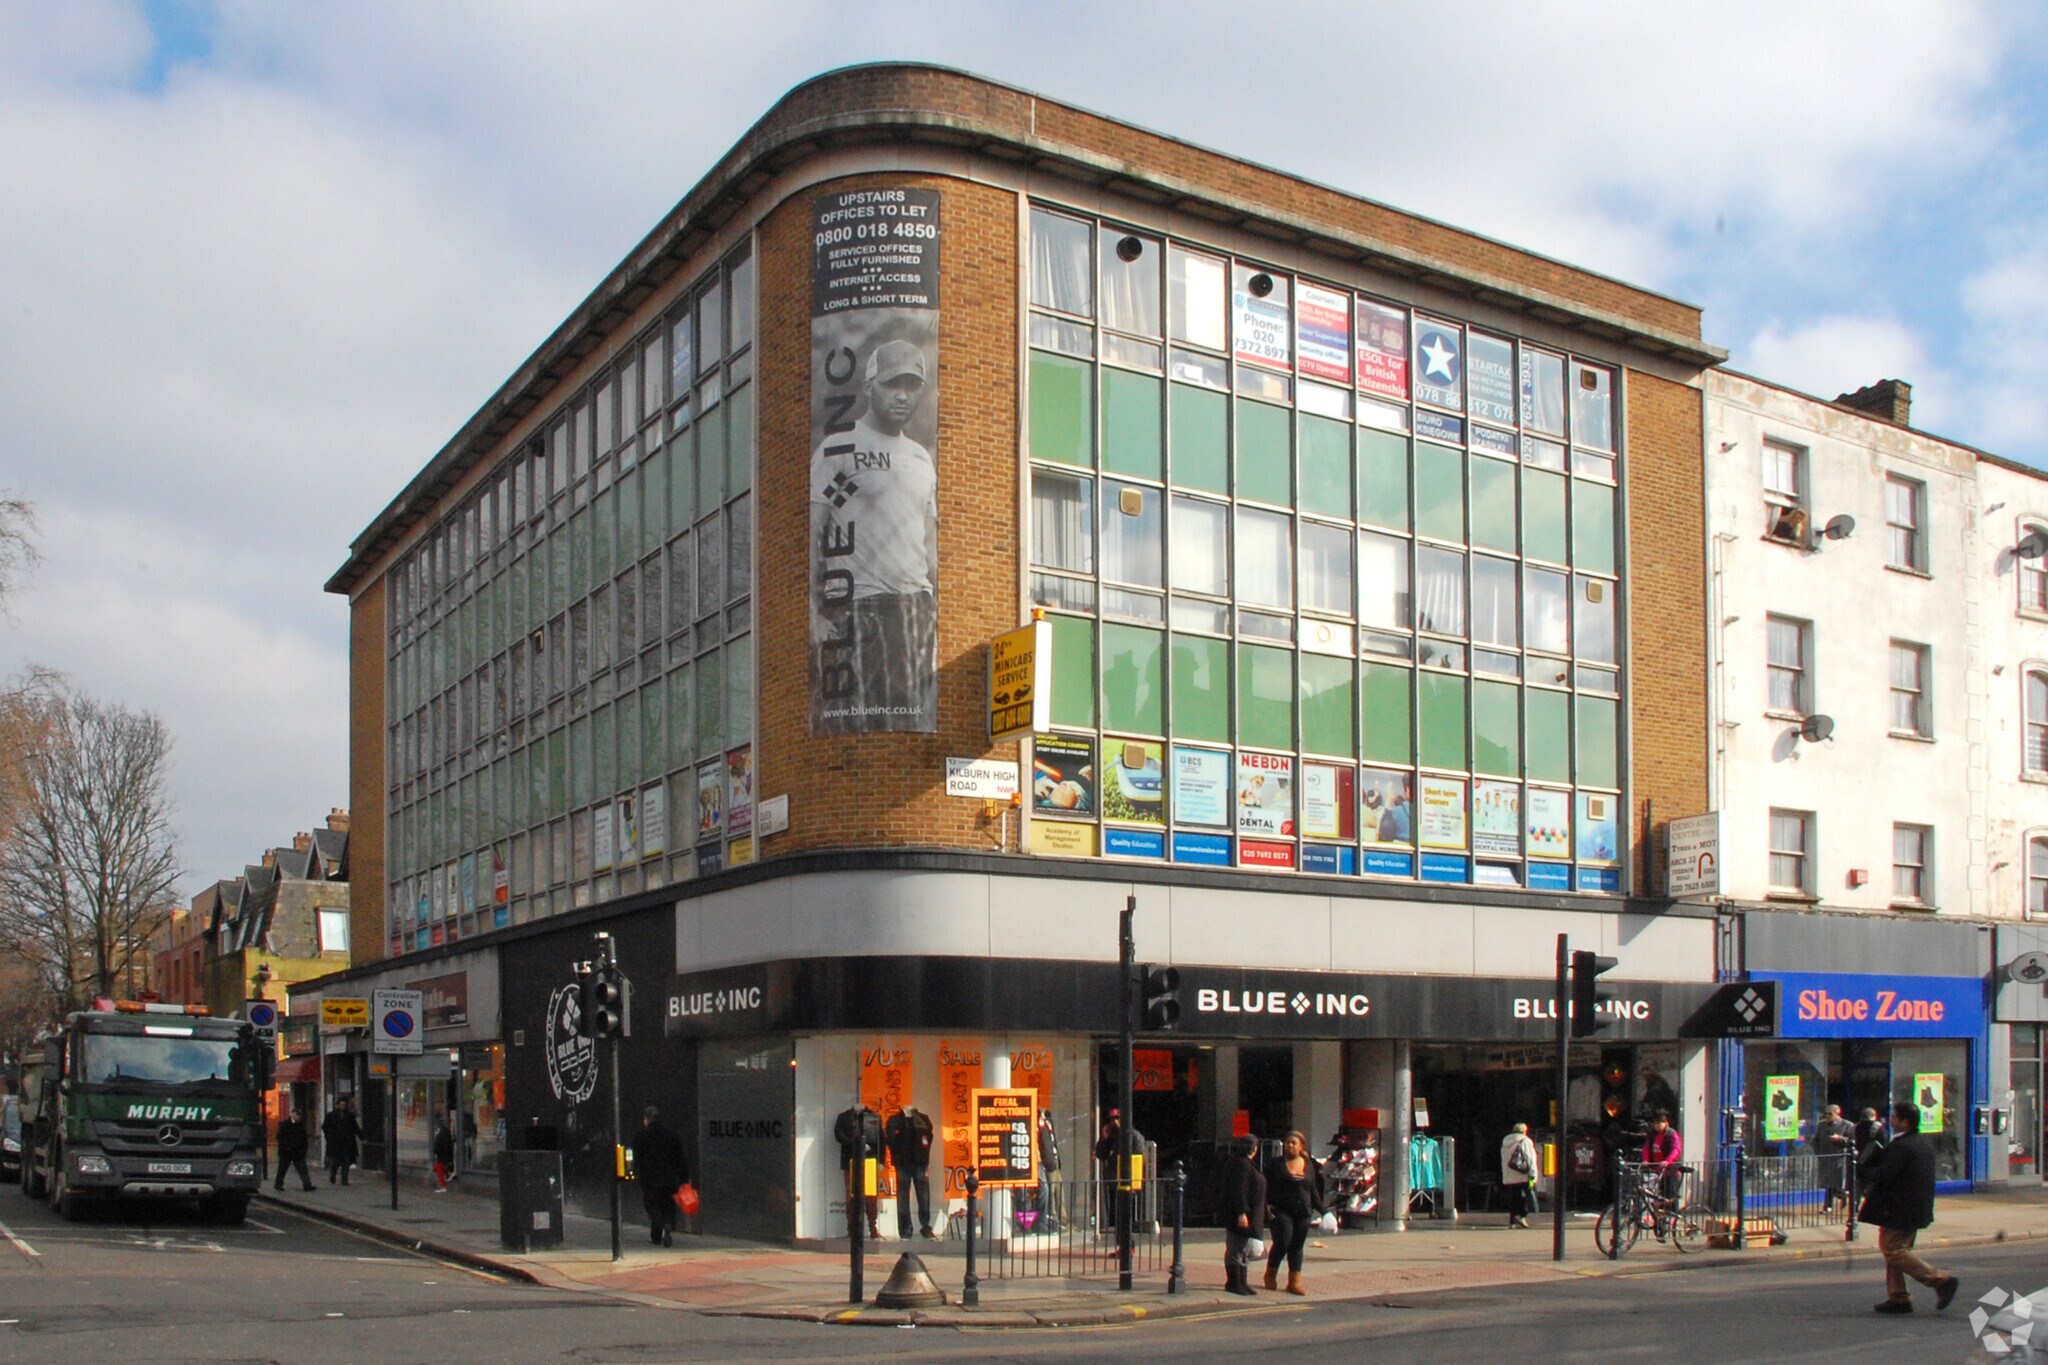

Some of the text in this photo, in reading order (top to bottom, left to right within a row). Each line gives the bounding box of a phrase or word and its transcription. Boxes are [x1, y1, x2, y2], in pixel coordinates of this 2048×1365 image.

[839, 191, 905, 206] UPSTAIRS
[821, 205, 927, 225] OFFICES TO LET
[816, 223, 936, 247] 0800 018 4850
[829, 244, 922, 259] SERVICED OFFICES
[831, 255, 920, 270] FULLY FURNISHED
[829, 274, 921, 288] INTERNET ACCESS
[823, 299, 849, 311] LONG
[861, 295, 896, 305] SHORT
[899, 295, 928, 305] TERM
[1253, 329, 1275, 344] 020
[1234, 338, 1262, 354] 7372
[1359, 350, 1402, 370] ESOL for
[1365, 364, 1397, 382] British
[1358, 375, 1406, 398] Citizenship
[1416, 386, 1461, 408] 078 86
[1522, 437, 1533, 462] 020
[854, 451, 891, 470] RAW
[822, 345, 857, 700] BLUE INC
[994, 651, 1033, 674] MINICABS
[997, 667, 1028, 687] SERVICE
[823, 704, 923, 719] www.blueinc.co.uk
[1241, 754, 1289, 770] NEBDN
[949, 767, 1016, 781] KILBURN HIGH
[950, 780, 978, 791] ROAD
[1424, 787, 1441, 795] Short
[1424, 797, 1449, 806] Courses
[1239, 818, 1274, 829] DENTAL
[1111, 838, 1157, 849] Quality Education
[1699, 840, 1716, 849] MOT
[1368, 859, 1385, 867] Quality
[1688, 855, 1696, 864] 33
[377, 991, 420, 1000] Controlled
[669, 986, 761, 1017] BLUE INC
[1197, 989, 1370, 1016] BLUE INC
[383, 1000, 413, 1009] ZONE
[1798, 990, 1945, 1021] Shoe Zone
[940, 1047, 980, 1066] SALE
[993, 1098, 1018, 1106] FINAL
[127, 1104, 212, 1120] MURPHY
[952, 1071, 969, 1162] LAST DAYS
[980, 1107, 1030, 1116] REDUCTIONS
[709, 1120, 782, 1138] BLUE INC
[980, 1134, 1030, 1146] JEANS £10
[1011, 1146, 1030, 1157] £10
[1011, 1158, 1030, 1169] £15
